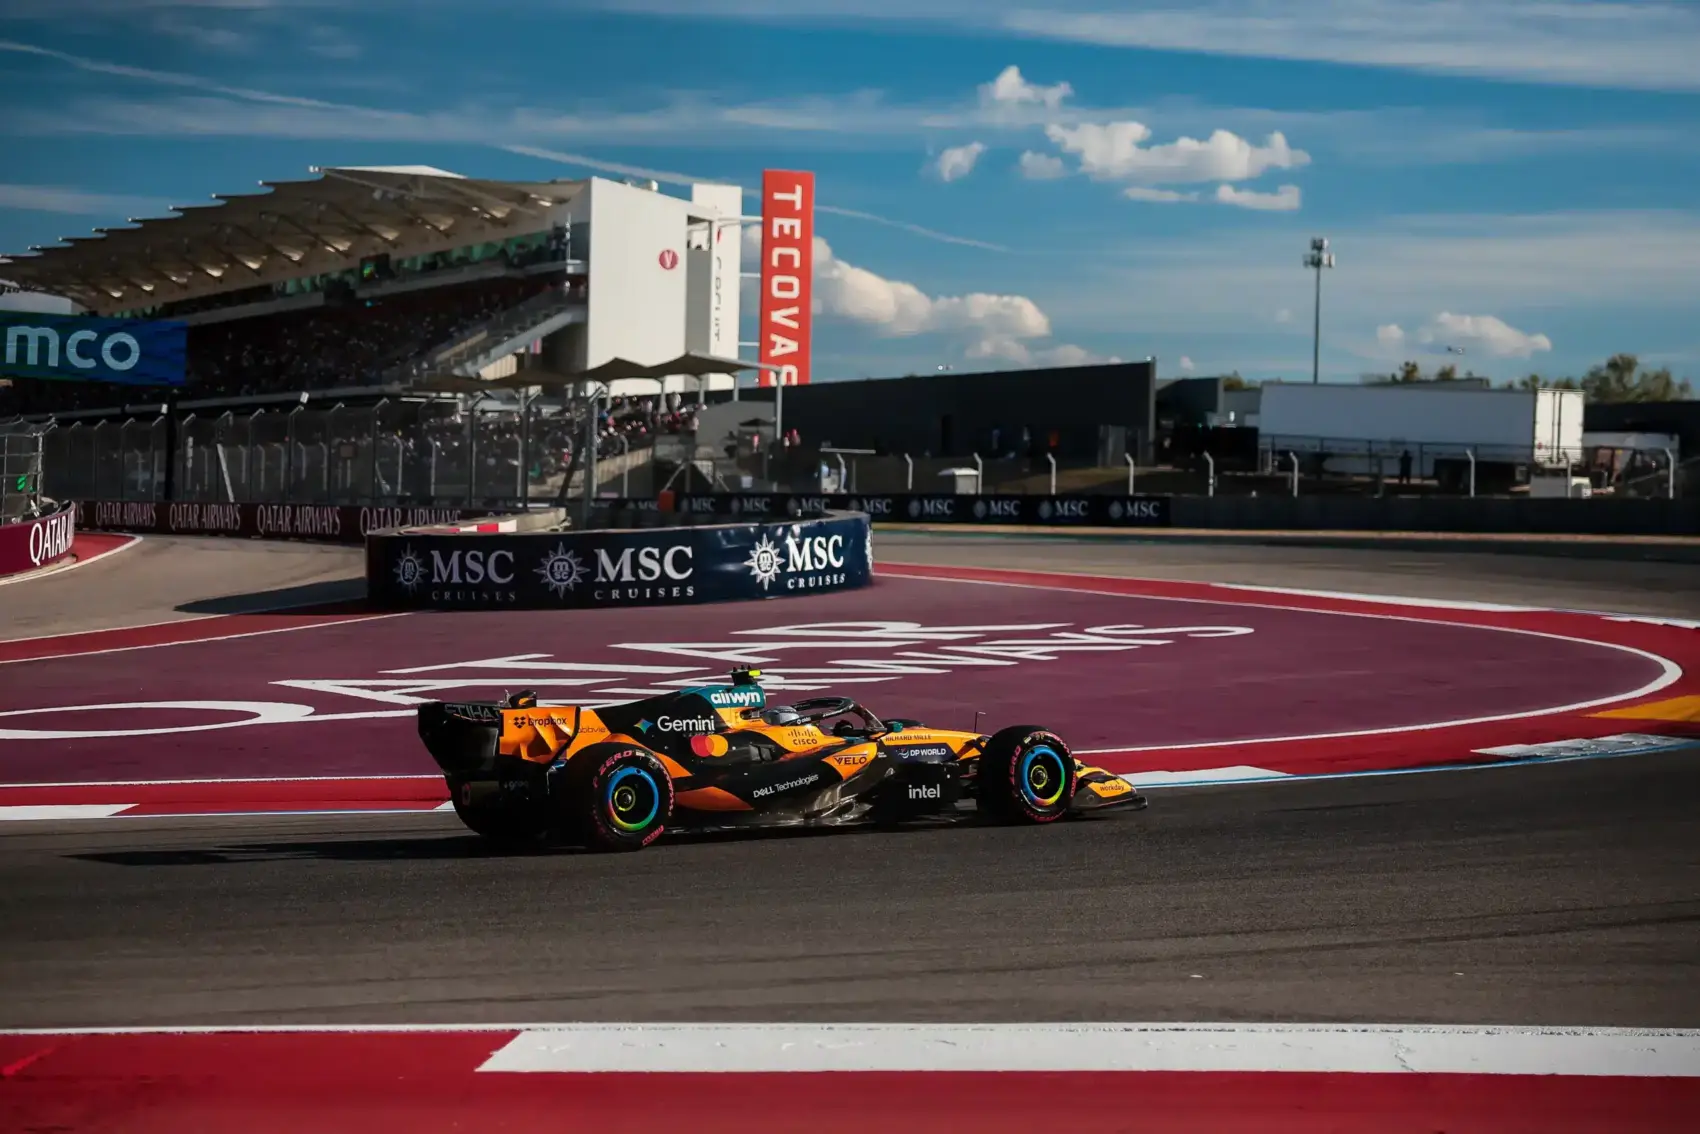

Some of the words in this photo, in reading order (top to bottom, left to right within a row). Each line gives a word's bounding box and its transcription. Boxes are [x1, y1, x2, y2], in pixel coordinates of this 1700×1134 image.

[6, 326, 140, 371] mco
[95, 502, 122, 525] QATAR
[862, 498, 892, 514] MSC
[922, 499, 954, 515] MSC
[989, 500, 1021, 516] MSC
[1055, 501, 1088, 517] MSC
[1126, 501, 1160, 518] MSC
[169, 503, 199, 531] QATAR
[201, 503, 240, 531] AIRWAYS
[256, 504, 290, 534] QATAR
[293, 505, 341, 535] AIRWAYS
[30, 514, 67, 567] QATAR
[784, 534, 844, 573] MSC
[430, 550, 515, 584] MSC
[594, 545, 693, 583] MSC
[787, 573, 846, 589] CRUISES
[431, 590, 516, 601] CRUISES
[594, 586, 694, 600] CRUISES
[657, 714, 715, 732] Gemini
[792, 738, 818, 746] CISCO
[834, 755, 868, 765] VELO
[910, 749, 920, 757] DP
[920, 748, 947, 756] WORLD
[753, 785, 775, 798] DELL
[774, 774, 819, 792] Technologies
[908, 783, 941, 799] intel
[1099, 783, 1125, 792] workday
